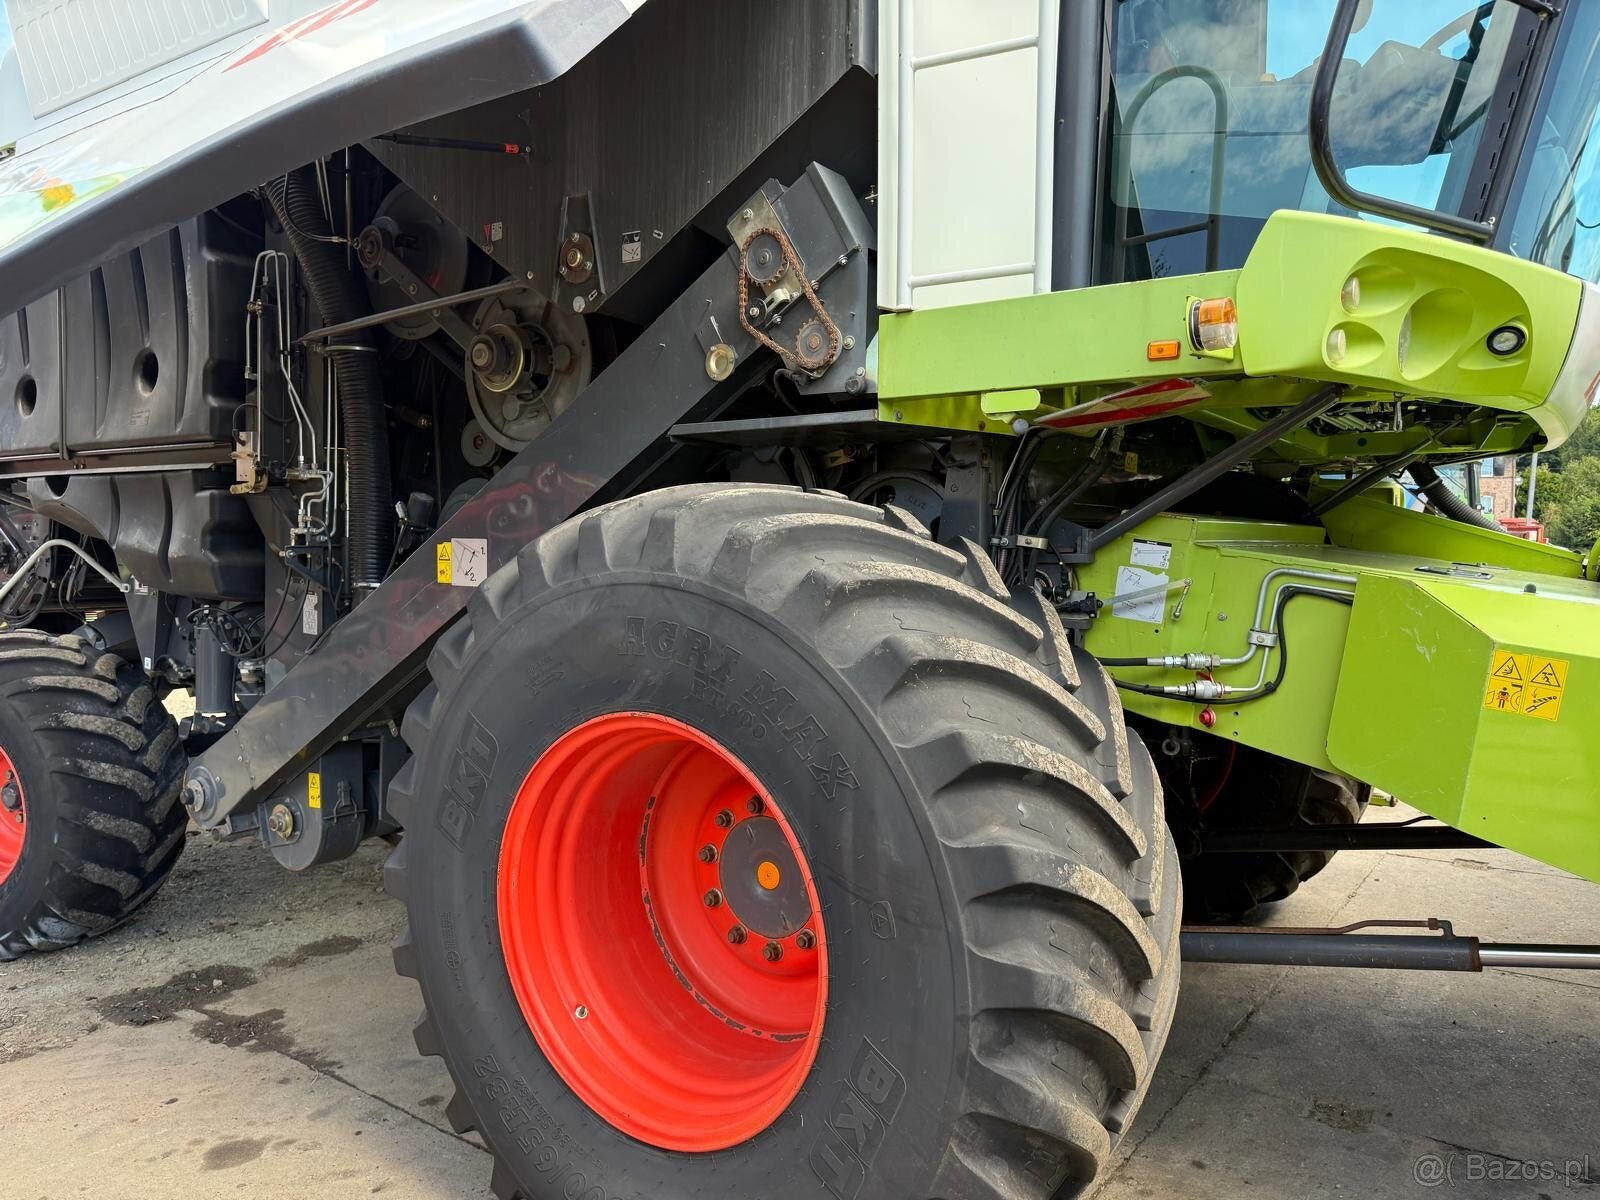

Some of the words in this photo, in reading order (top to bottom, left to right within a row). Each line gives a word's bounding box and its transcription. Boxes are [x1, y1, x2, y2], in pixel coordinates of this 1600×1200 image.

[439, 713, 496, 848] BKT
[740, 668, 861, 800] MAX
[813, 1040, 904, 1198] BKT
